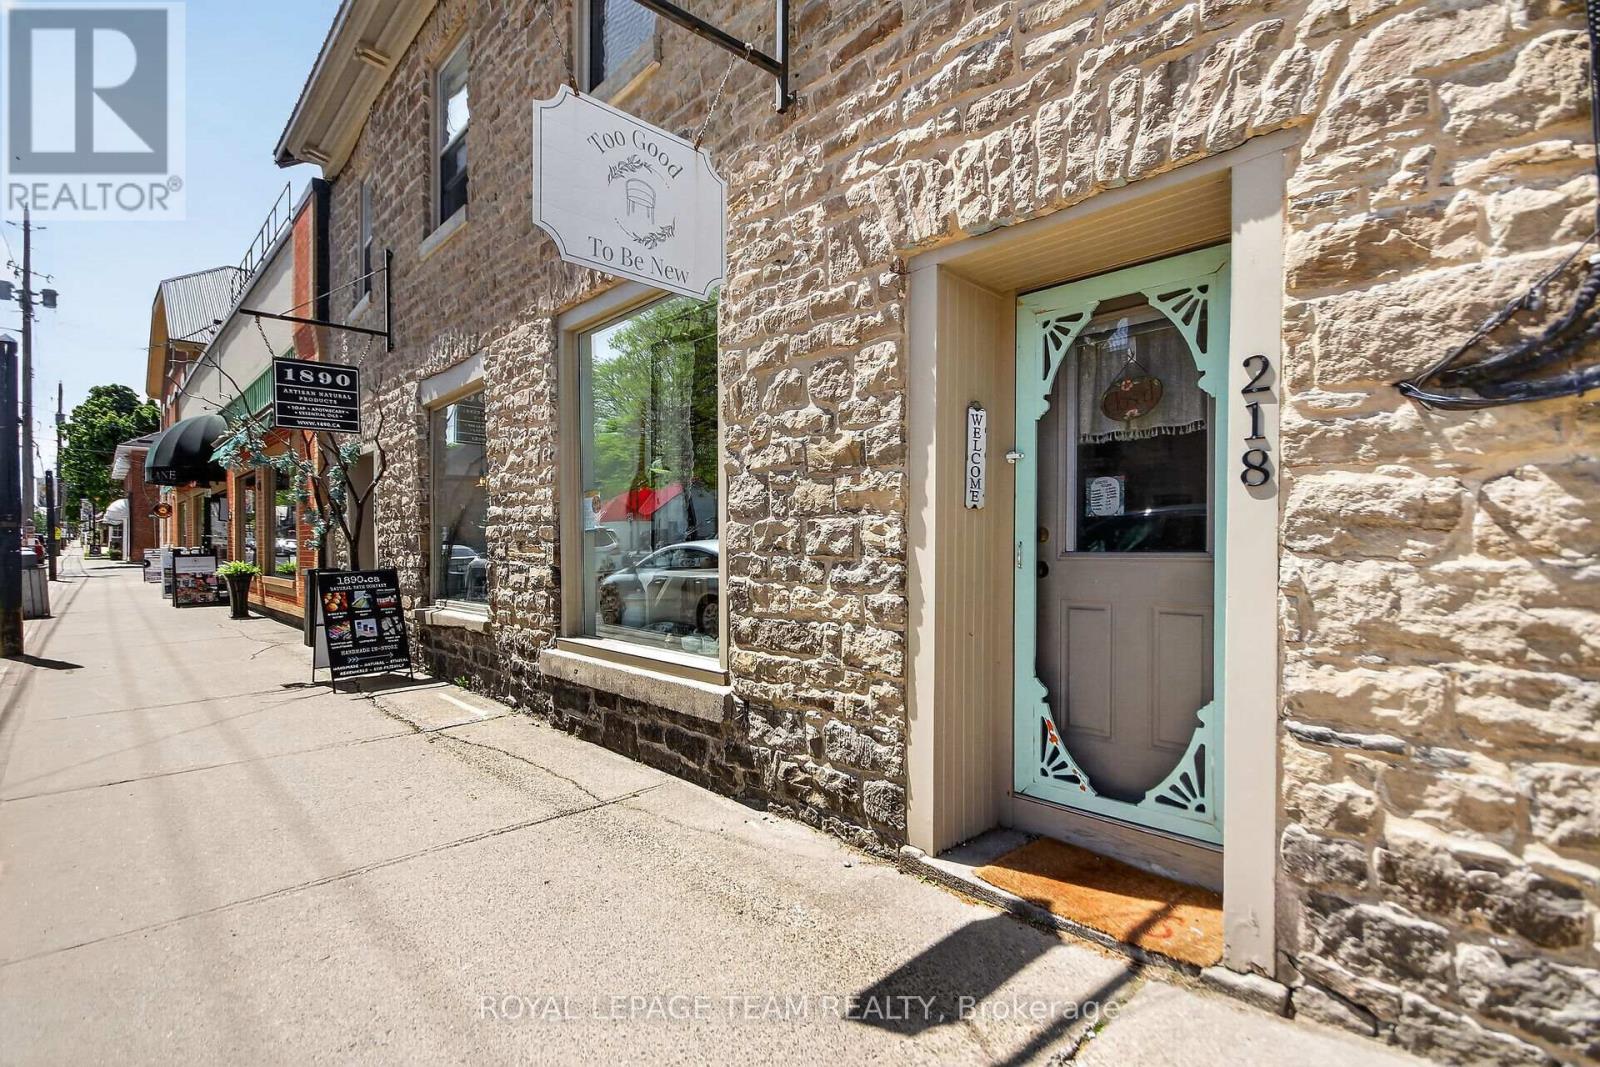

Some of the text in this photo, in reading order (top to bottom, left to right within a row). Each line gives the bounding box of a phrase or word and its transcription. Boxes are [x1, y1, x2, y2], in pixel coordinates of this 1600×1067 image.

[587, 129, 683, 179] Too Good
[588, 235, 690, 285] To Be New
[284, 368, 351, 387] 1890
[283, 388, 352, 400] ARTISAN NATURAL
[299, 396, 338, 404] PRODUCTS
[1240, 354, 1271, 487] 218
[970, 413, 983, 503] WELCOME
[336, 575, 380, 586] 1890.ca
[340, 648, 371, 656] HANDMADE
